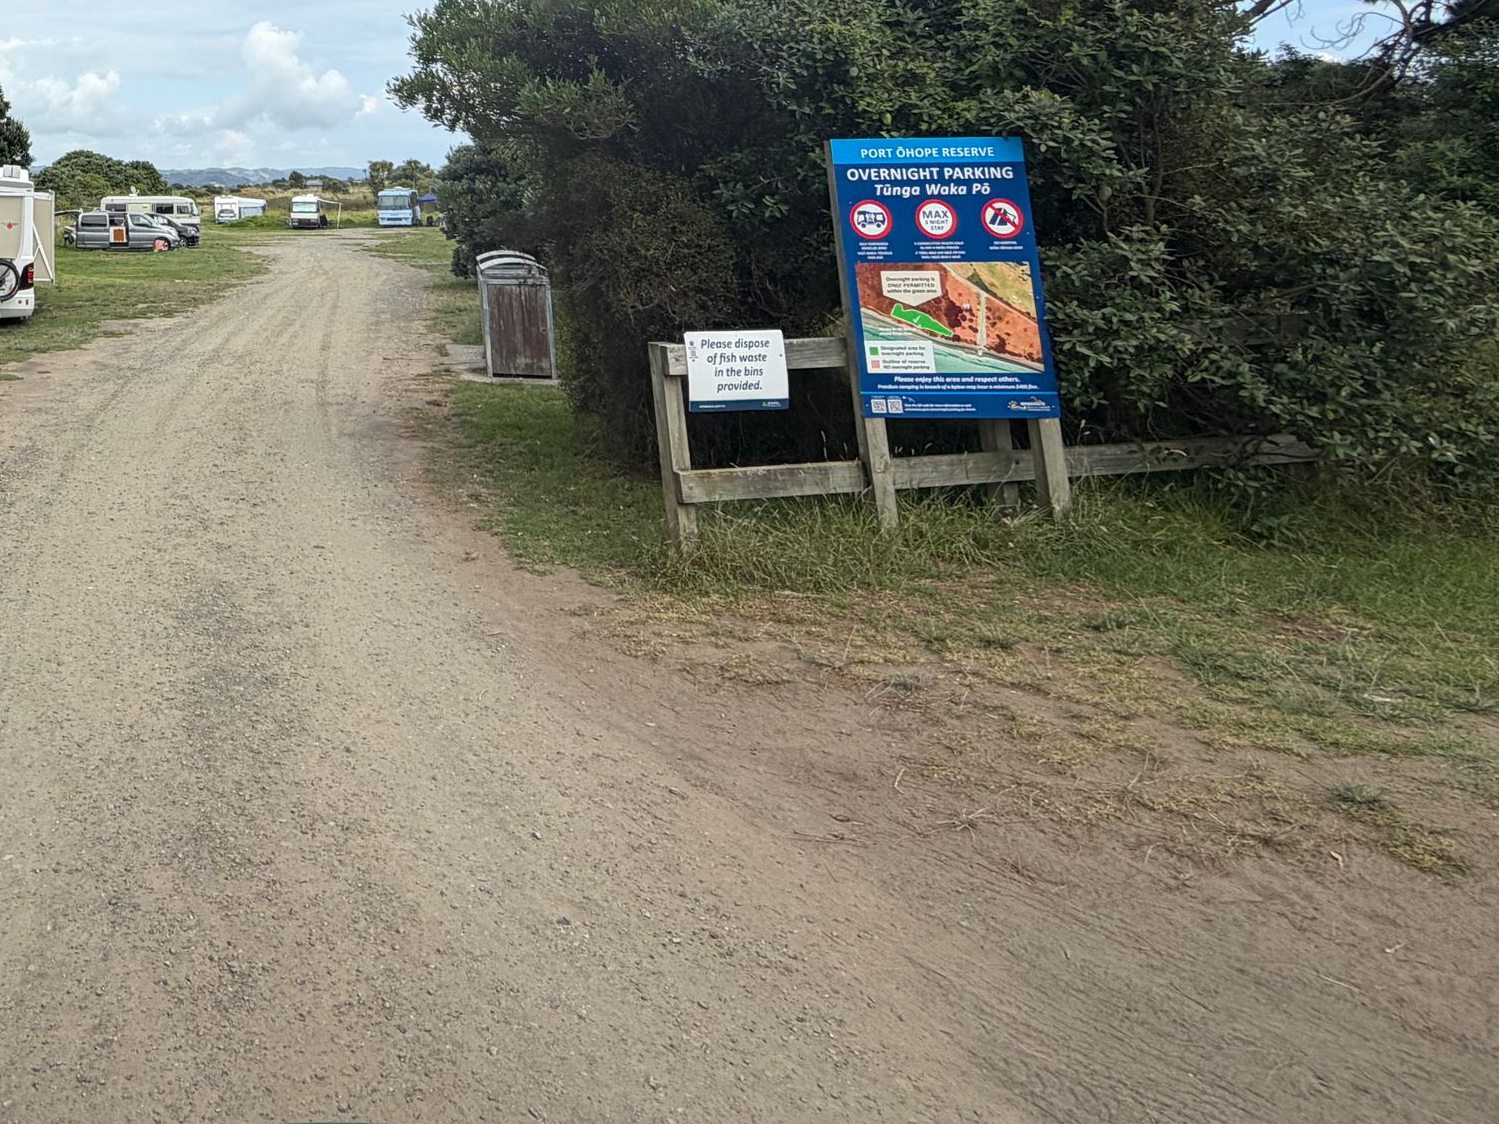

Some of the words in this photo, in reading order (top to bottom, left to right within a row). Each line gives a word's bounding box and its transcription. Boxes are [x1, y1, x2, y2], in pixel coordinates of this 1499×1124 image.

[860, 148, 892, 158] PORT
[896, 146, 939, 158] ŌHOPE
[942, 146, 994, 157] RESERVE
[846, 167, 940, 181] OVERNIGHT
[944, 166, 1014, 180] PARKING
[874, 183, 920, 198] Tūnga
[926, 184, 967, 196] Waka
[972, 182, 990, 194] Pō
[922, 210, 949, 219] MAX
[701, 339, 732, 349] Please
[735, 338, 770, 350] dispose
[707, 353, 718, 365] of
[719, 353, 736, 365] fish
[739, 354, 767, 363] waste
[714, 367, 724, 377] in
[726, 367, 742, 377] the
[744, 367, 763, 376] bins
[717, 380, 762, 393] provided.
